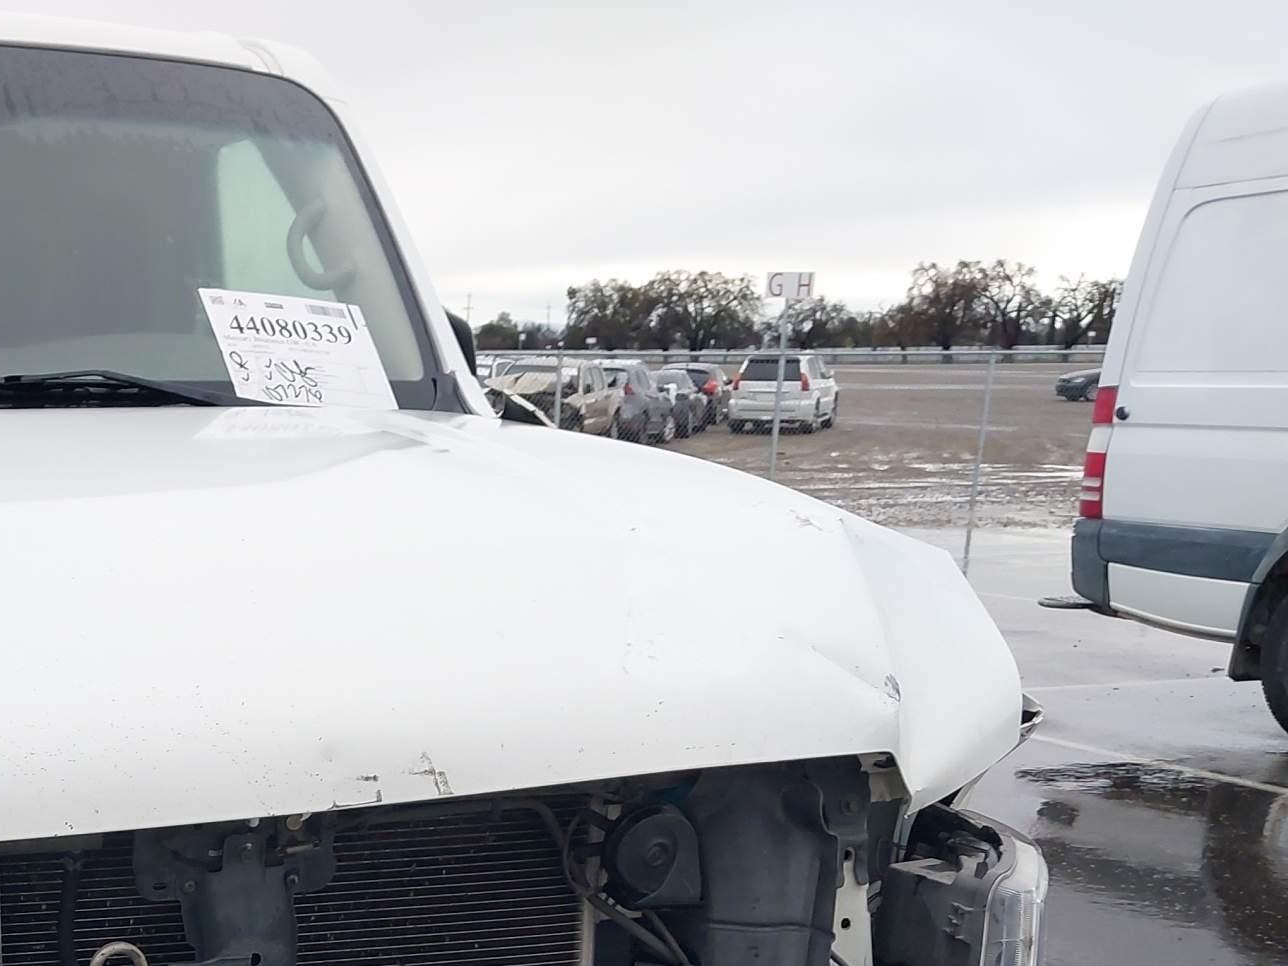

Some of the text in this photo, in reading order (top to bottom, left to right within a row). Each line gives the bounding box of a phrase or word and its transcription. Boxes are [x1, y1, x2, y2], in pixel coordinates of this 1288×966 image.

[768, 272, 813, 297] G H
[229, 315, 352, 345] 44080339
